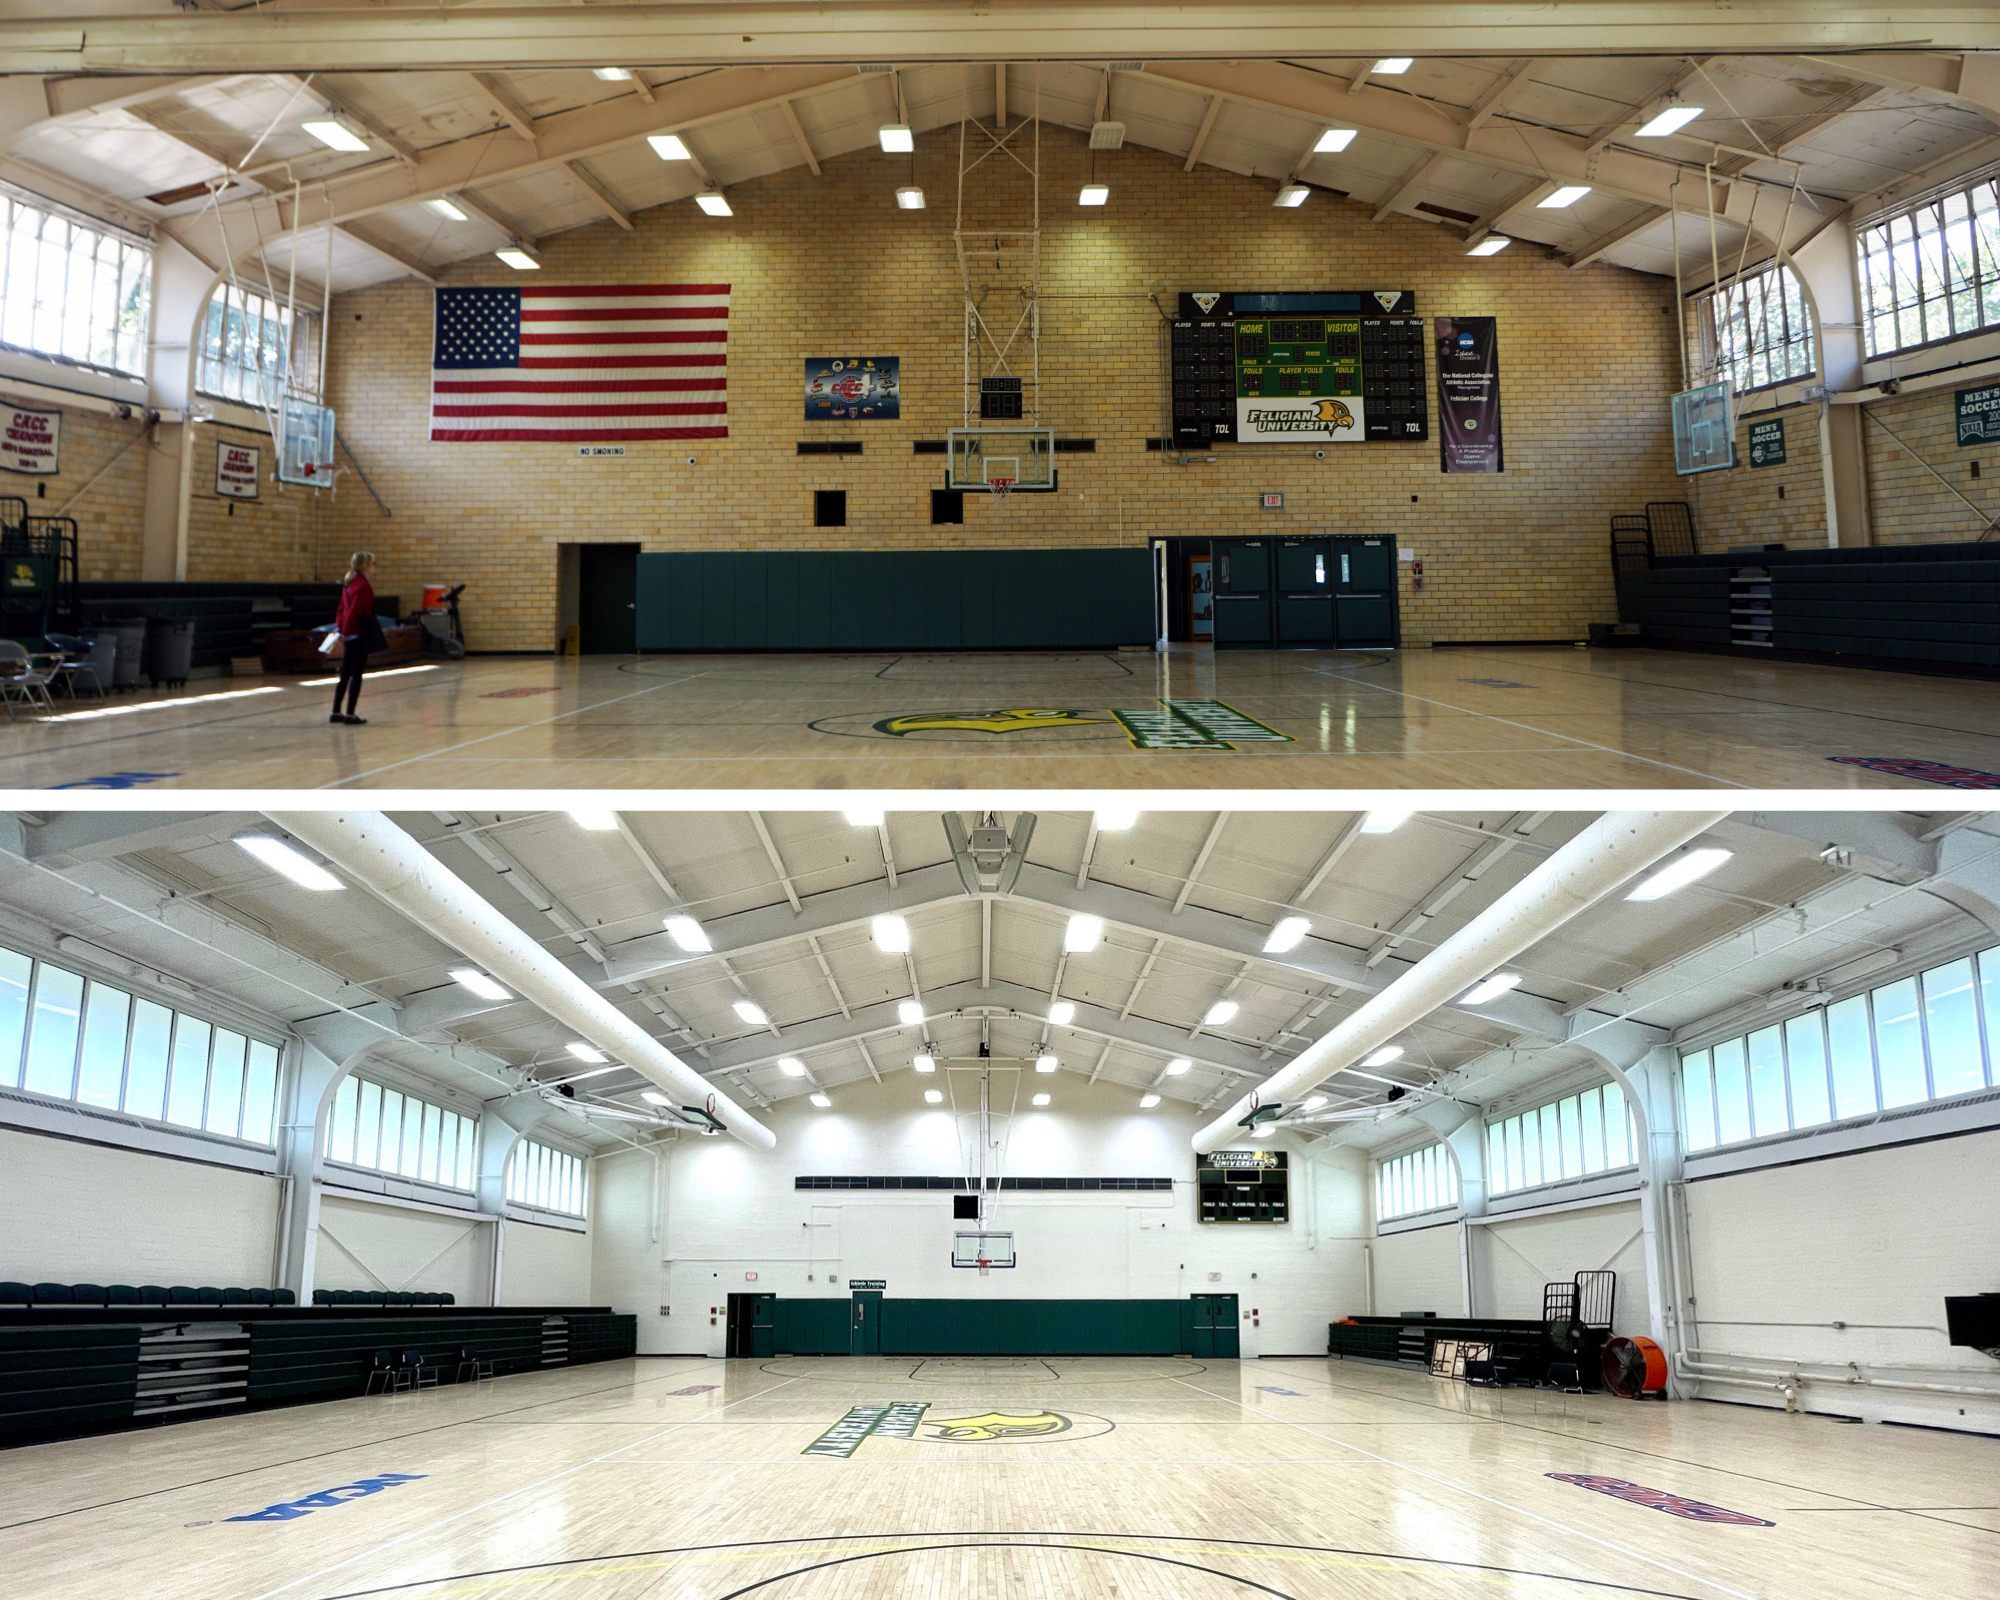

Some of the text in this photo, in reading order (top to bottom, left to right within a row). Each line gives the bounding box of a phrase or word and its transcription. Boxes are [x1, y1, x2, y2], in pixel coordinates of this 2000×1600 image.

[1240, 324, 1263, 334] HOME
[1327, 323, 1358, 333] VISITOR
[831, 383, 863, 392] CACC
[1964, 388, 2000, 403] MEN'S
[1960, 399, 2000, 415] SOCCE
[1248, 410, 1312, 422] FELICIAN
[13, 413, 48, 432] CACC
[1257, 421, 1336, 431] UNIVERSITY
[1406, 423, 1420, 432] TOL
[1215, 424, 1230, 434] TOL
[1754, 423, 1777, 434] MEN'S
[1961, 422, 1983, 438] NAIA
[1752, 432, 1781, 443] SOCCER
[227, 449, 250, 463] CACC
[1267, 496, 1279, 505] EXIT
[220, 1473, 429, 1523] NCAA
